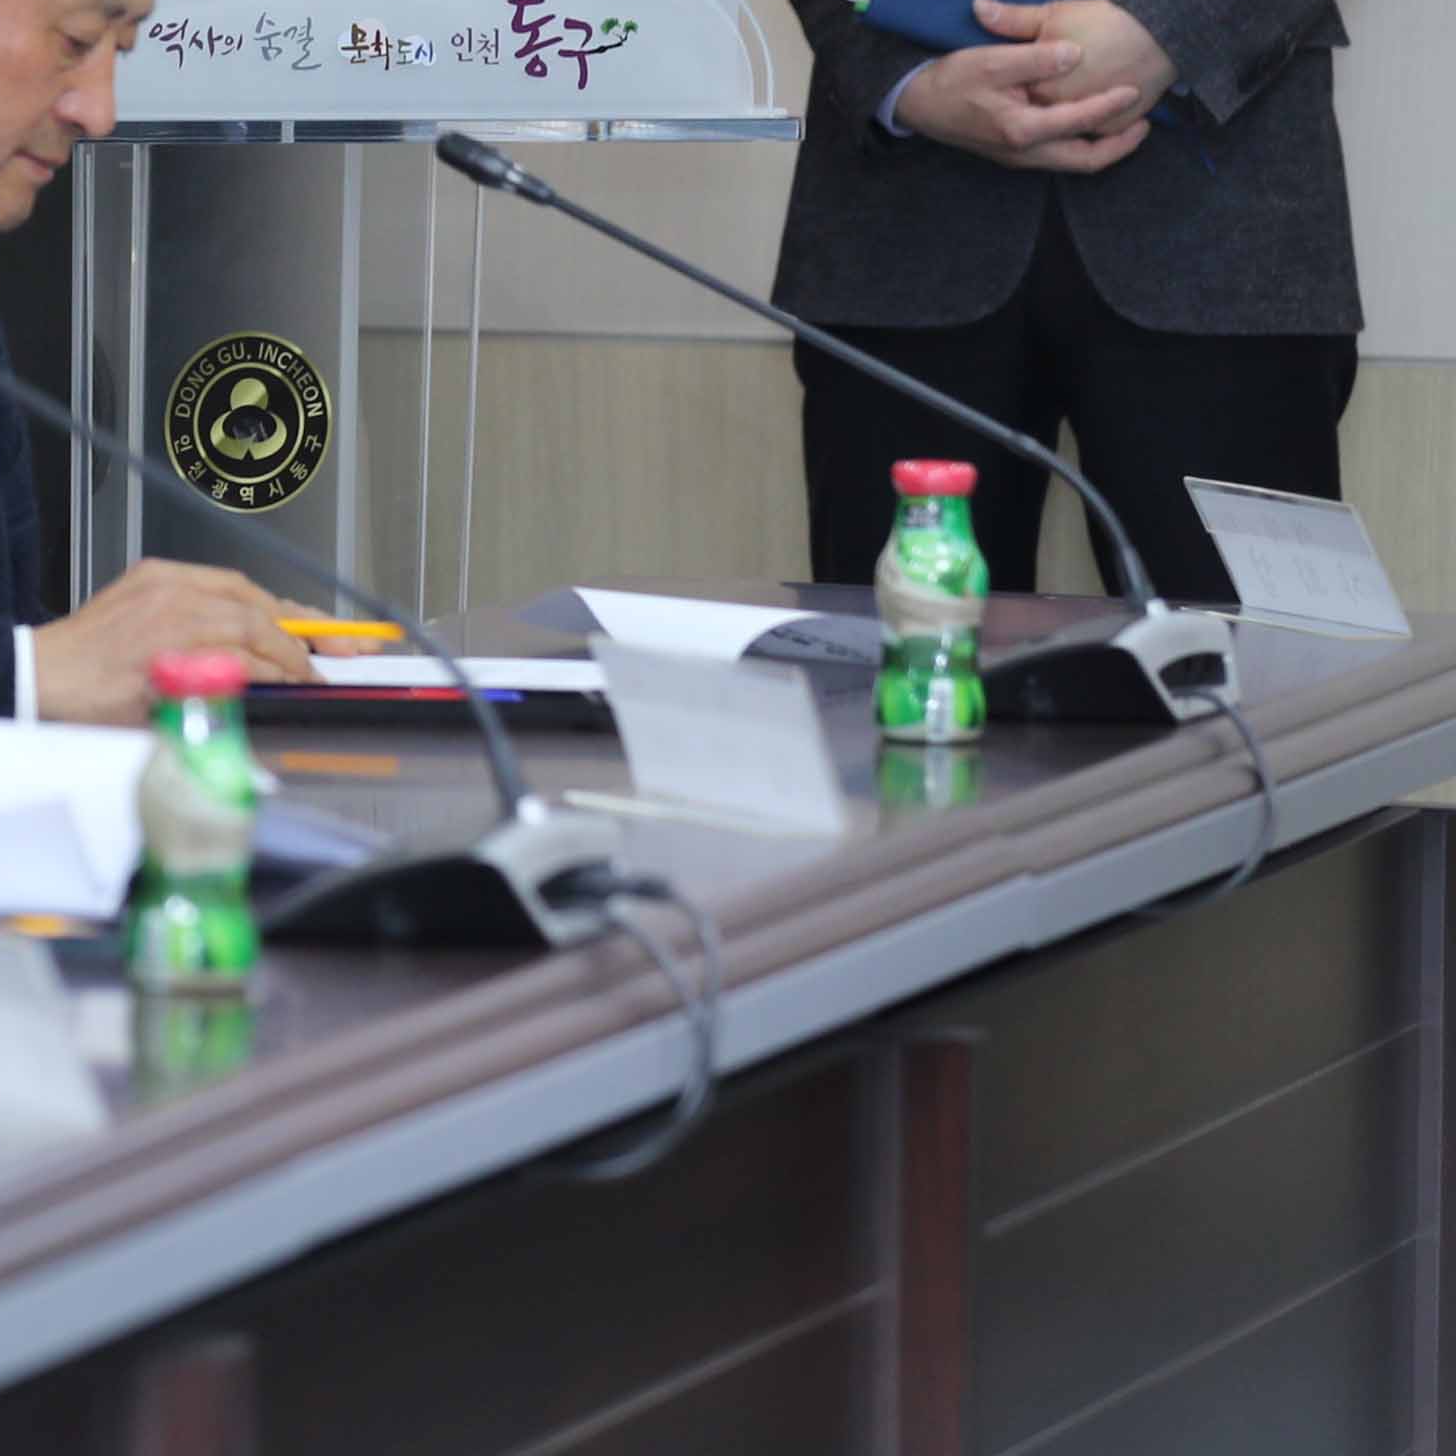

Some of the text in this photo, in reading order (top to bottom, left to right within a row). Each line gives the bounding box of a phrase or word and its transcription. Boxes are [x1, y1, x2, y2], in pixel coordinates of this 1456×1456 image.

[149, 18, 244, 69] 역사의
[253, 11, 322, 71] 숨결
[340, 24, 434, 70] 문화도시
[450, 28, 500, 65] 인천
[176, 358, 215, 419] DONG
[258, 342, 324, 418] INCHEON
